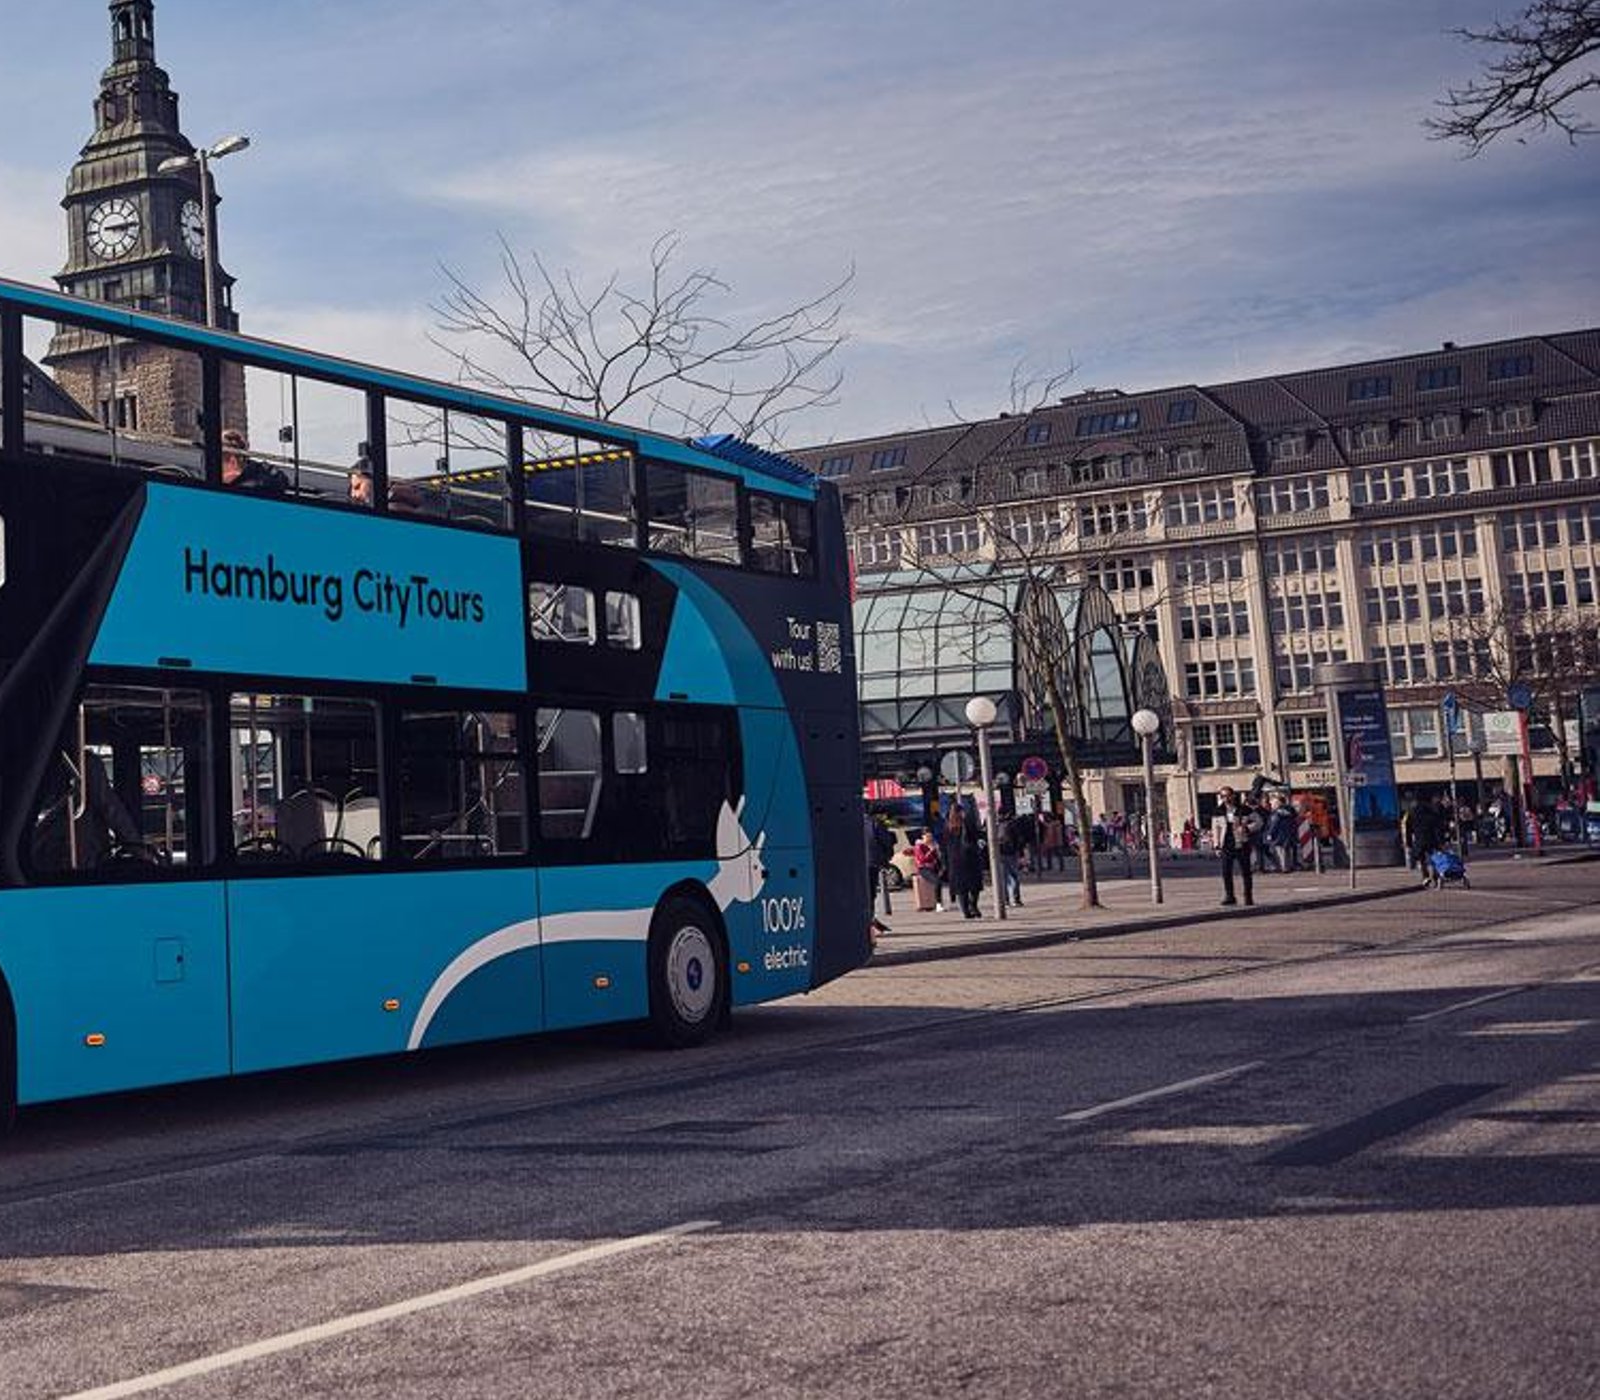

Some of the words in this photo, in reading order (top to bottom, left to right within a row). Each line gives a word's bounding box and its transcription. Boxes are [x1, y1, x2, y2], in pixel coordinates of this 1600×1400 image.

[184, 546, 343, 622] Hamburg
[352, 569, 484, 628] CityTours
[786, 616, 811, 640] Tour
[771, 647, 796, 670] with
[761, 896, 806, 933] 100%
[764, 945, 808, 971] electric
